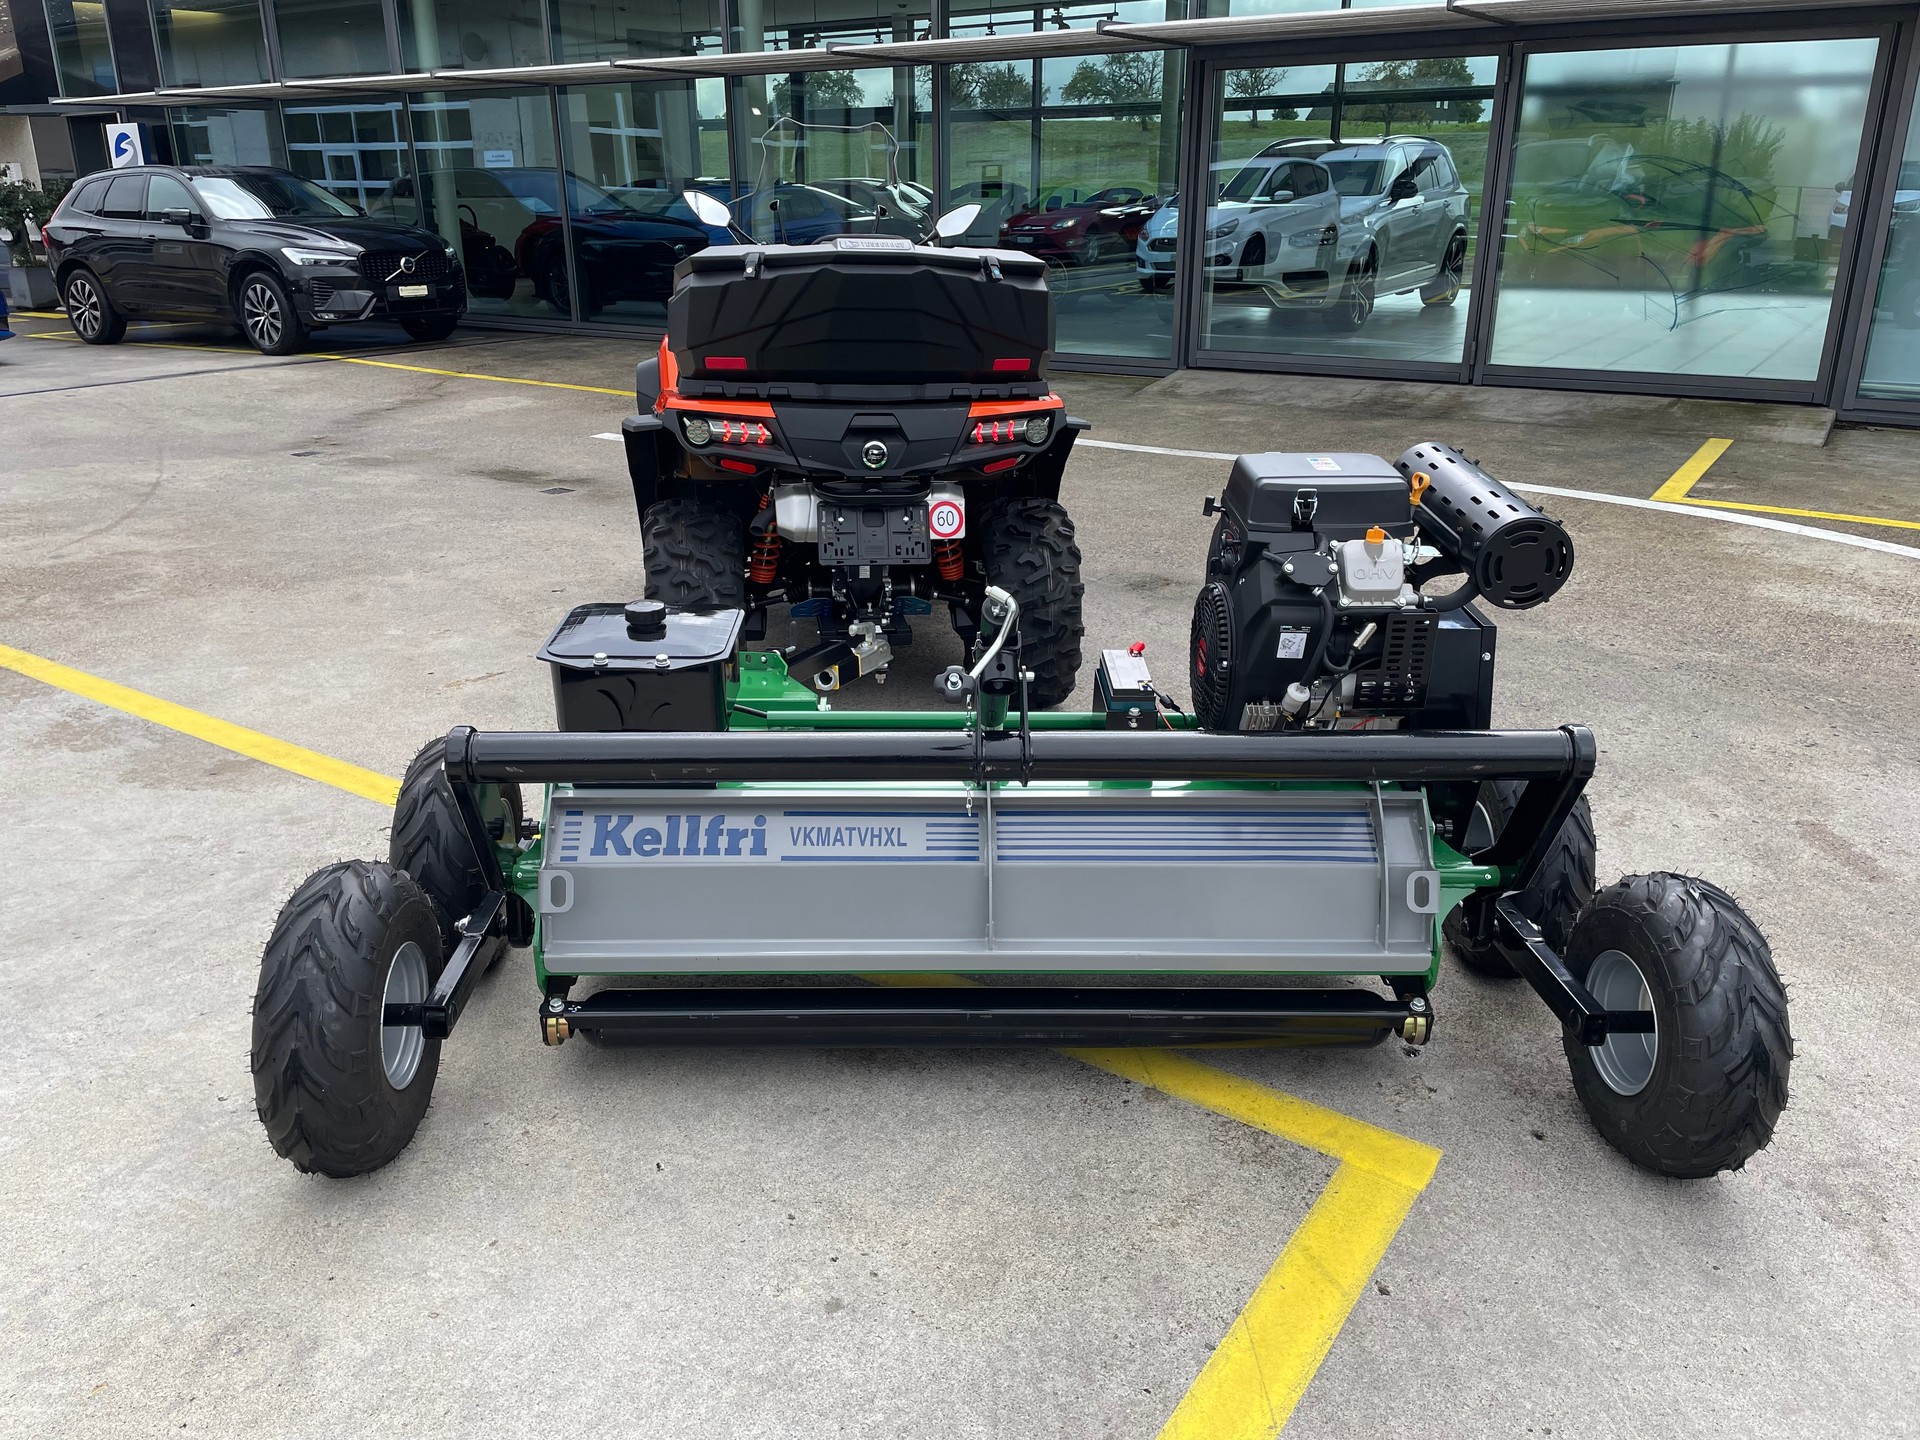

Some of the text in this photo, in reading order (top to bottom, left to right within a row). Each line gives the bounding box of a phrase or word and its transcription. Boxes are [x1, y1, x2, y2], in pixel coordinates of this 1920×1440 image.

[937, 510, 955, 527] 60
[1353, 568, 1396, 580] OHV
[589, 814, 908, 857] Kellfri VKMATVHXL
